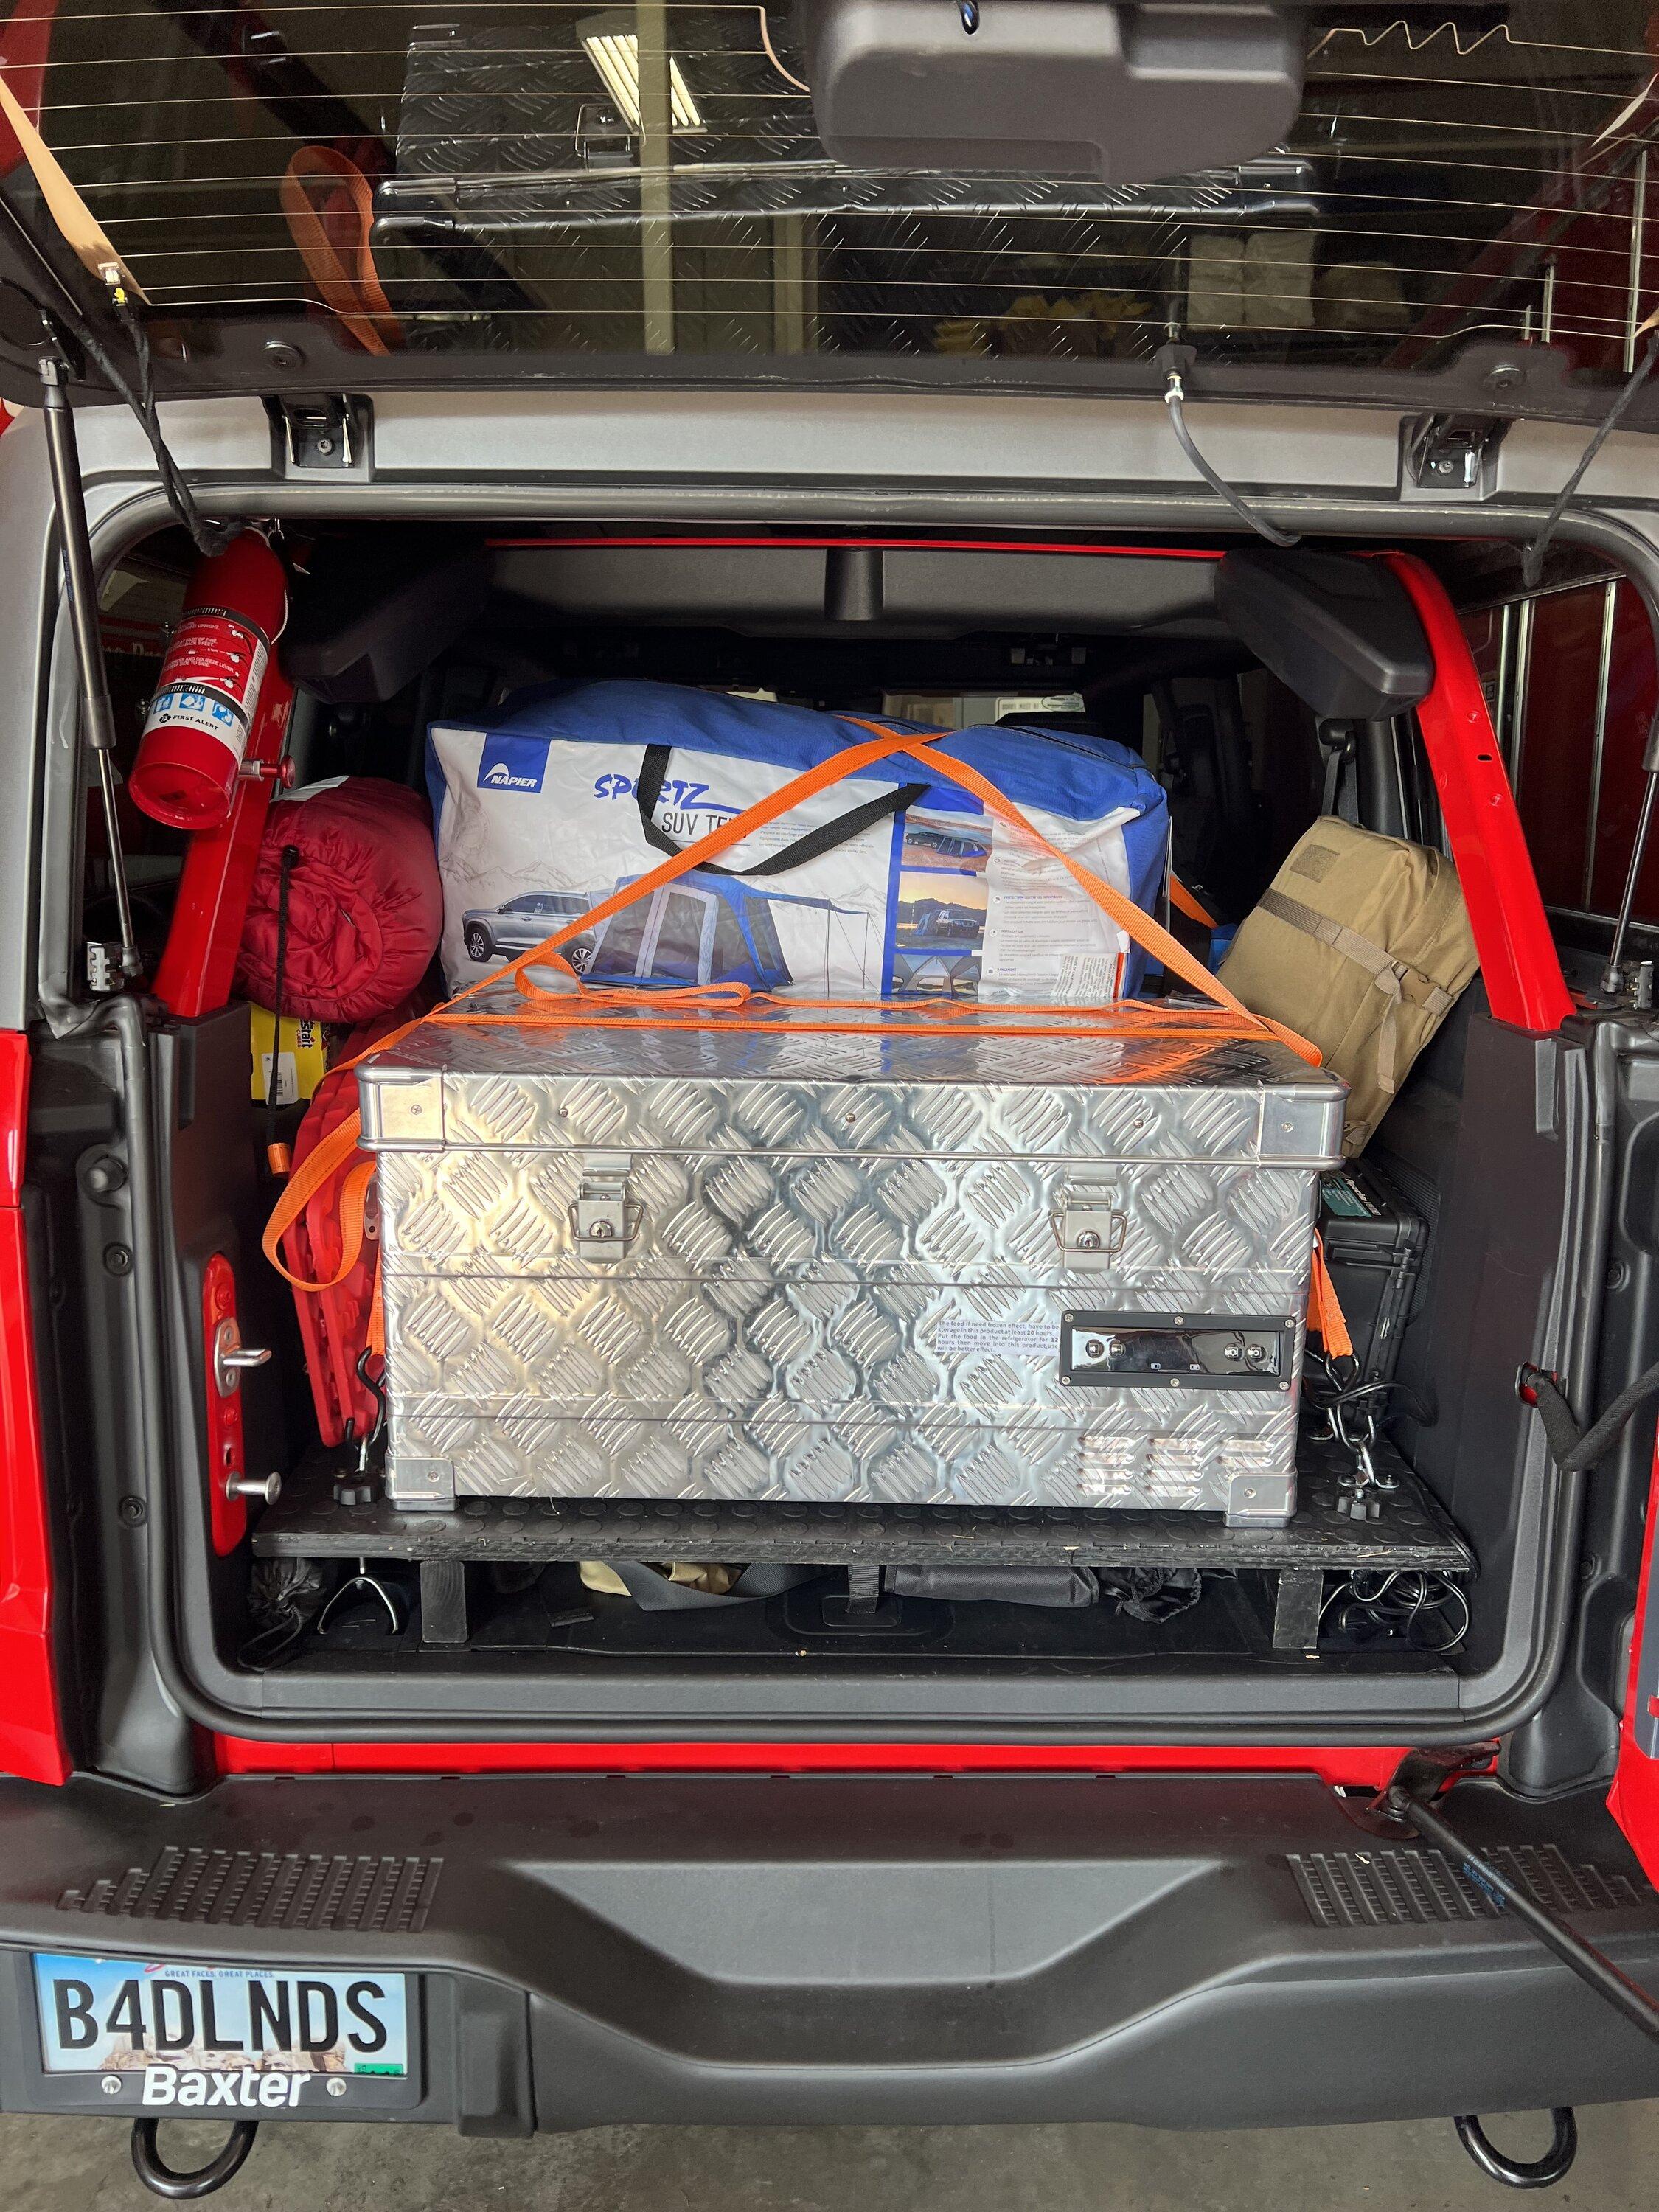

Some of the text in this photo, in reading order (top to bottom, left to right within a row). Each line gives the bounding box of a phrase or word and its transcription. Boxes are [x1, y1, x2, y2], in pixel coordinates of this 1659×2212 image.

[195, 718, 220, 731] ALERT
[490, 775, 538, 787] NAPIER
[661, 812, 698, 835] SUV
[705, 814, 740, 835] TE
[52, 1978, 388, 2053] B4DLNDS
[142, 2064, 311, 2108] Baxter
